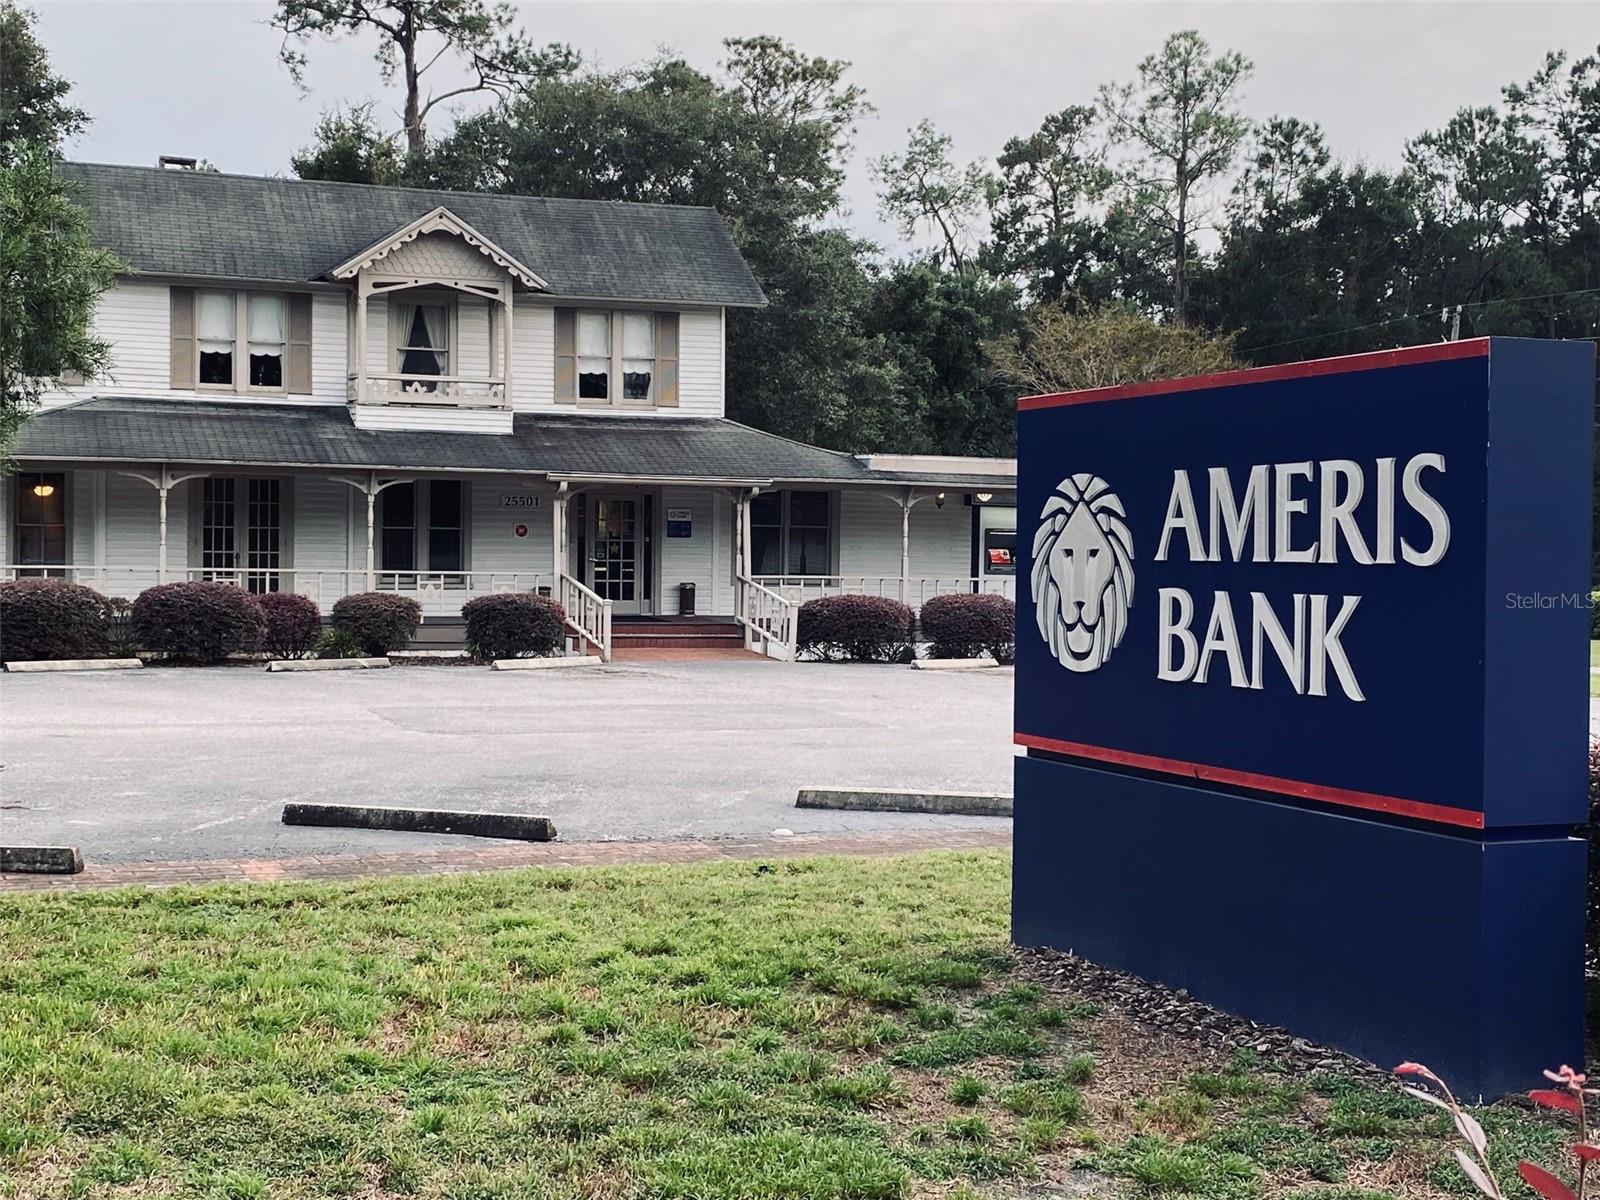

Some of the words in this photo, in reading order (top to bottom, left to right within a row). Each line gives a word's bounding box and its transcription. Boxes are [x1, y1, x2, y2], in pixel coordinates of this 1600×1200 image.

[504, 496, 539, 507] 25501
[1154, 452, 1451, 567] AMERIS
[1156, 587, 1366, 702] BANK
